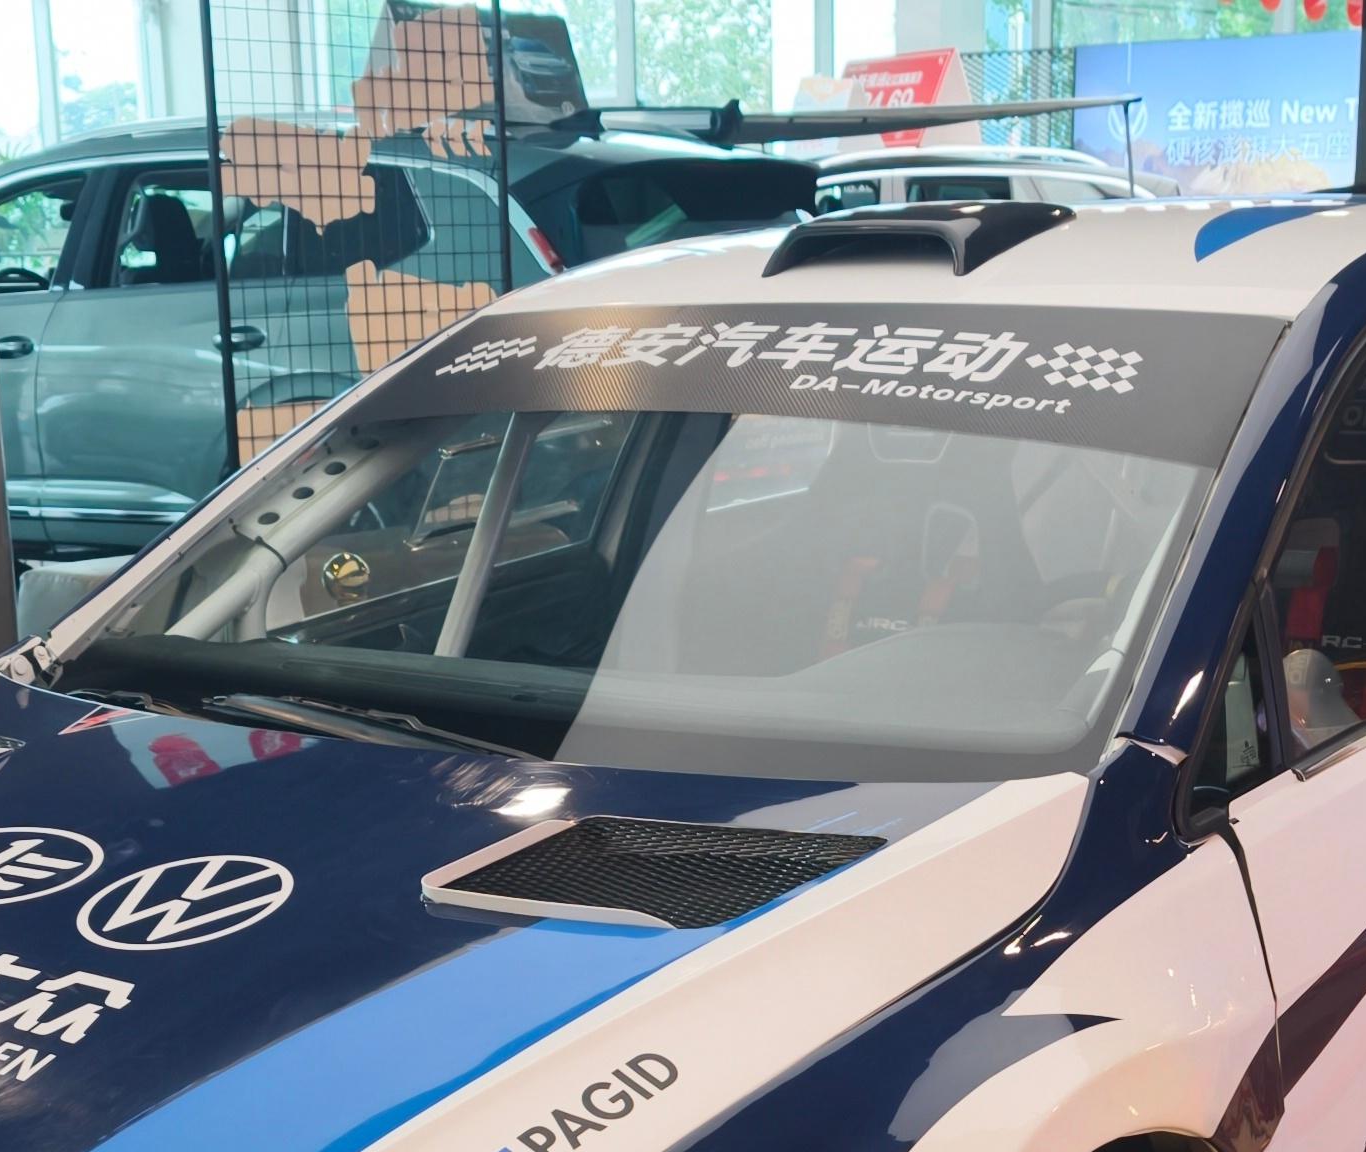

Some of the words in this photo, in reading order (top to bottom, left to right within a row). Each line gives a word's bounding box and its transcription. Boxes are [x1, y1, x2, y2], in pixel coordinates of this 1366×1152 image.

[1167, 100, 1271, 131] 全新揽巡
[1281, 100, 1337, 124] New
[534, 321, 1030, 383] 德安汽车运动
[789, 373, 1072, 415] DA-Motorsport
